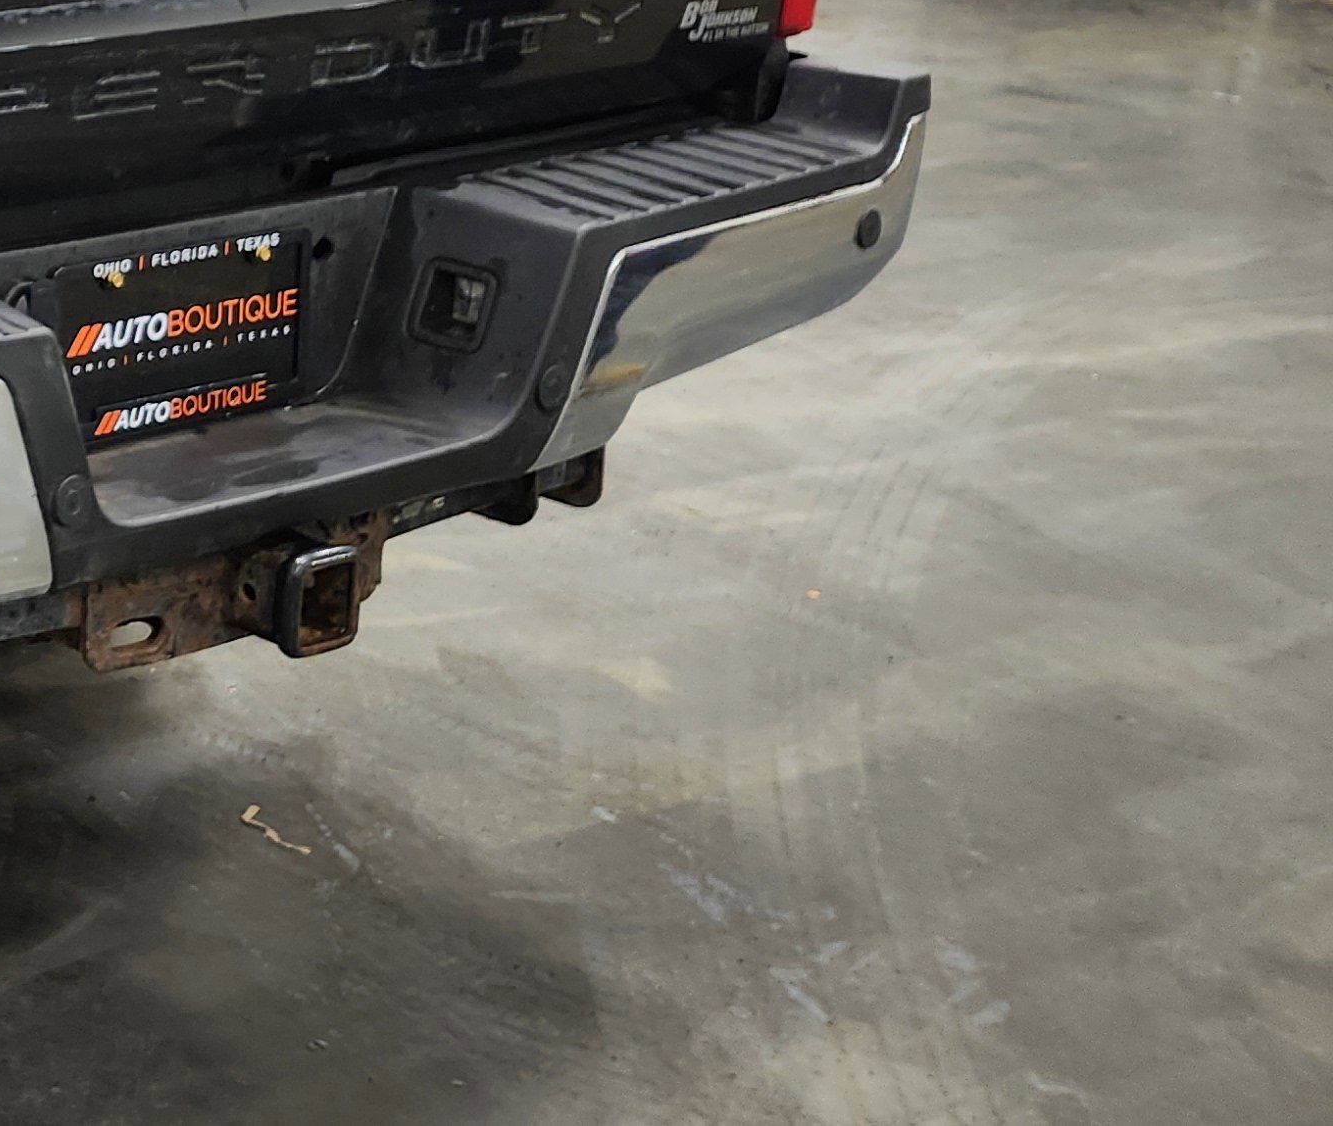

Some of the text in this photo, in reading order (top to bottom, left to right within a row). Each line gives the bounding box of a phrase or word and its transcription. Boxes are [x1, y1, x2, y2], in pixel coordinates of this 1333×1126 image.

[93, 232, 281, 279] OHIO FLORIDA TEXAS
[91, 288, 300, 353] AUTOBOUTIQUE
[113, 380, 268, 432] AUTOBOUTIQUE
